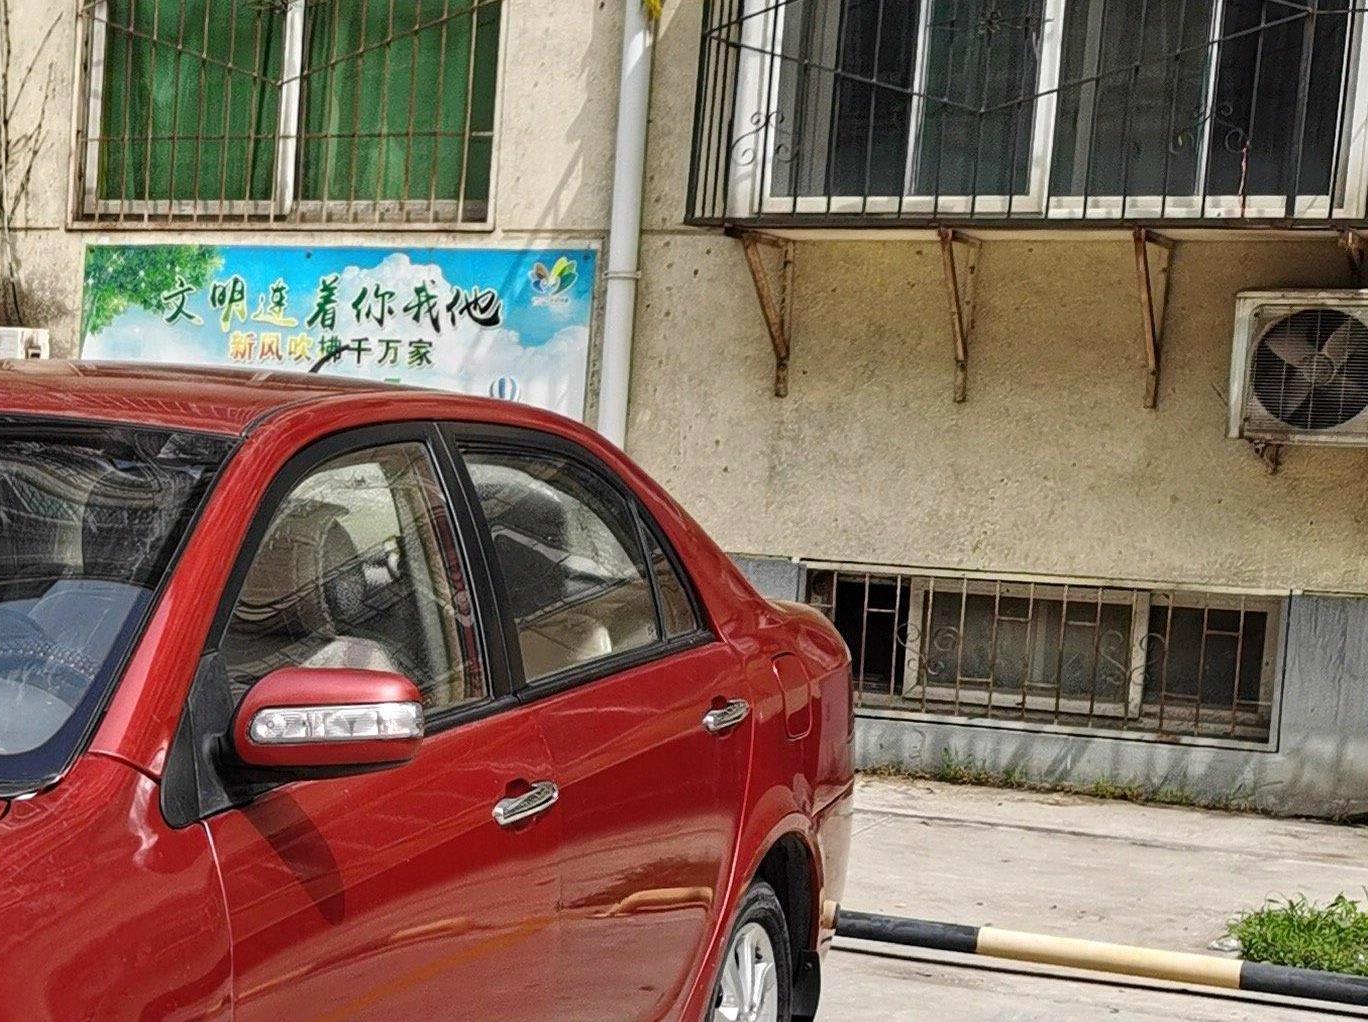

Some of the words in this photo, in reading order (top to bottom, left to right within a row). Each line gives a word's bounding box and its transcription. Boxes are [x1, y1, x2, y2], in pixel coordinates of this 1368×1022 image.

[229, 333, 433, 367] 新风吹拂千万家
